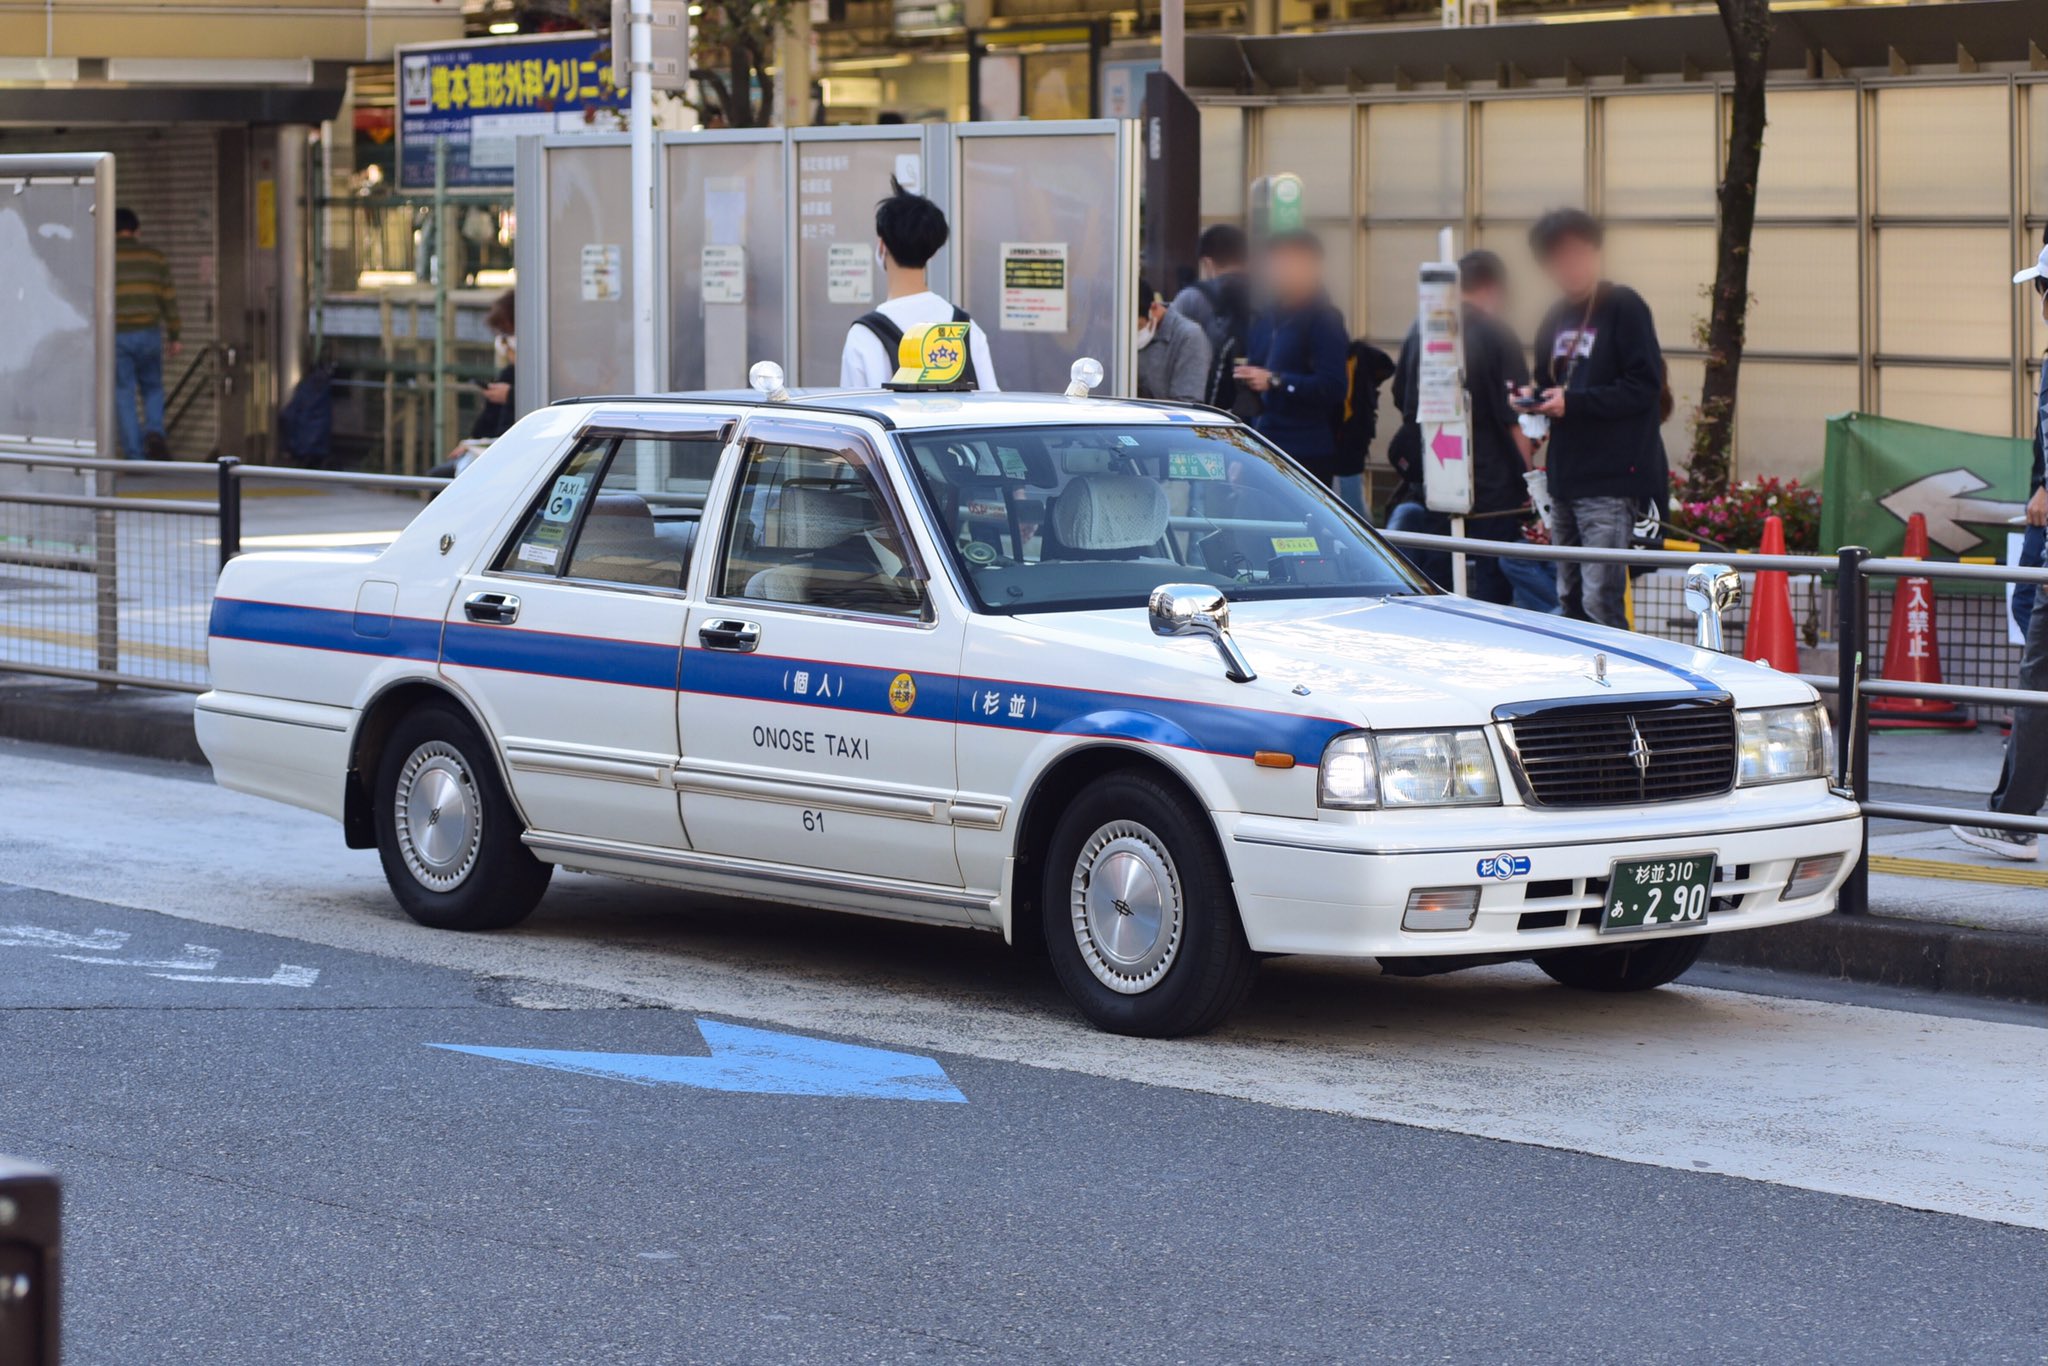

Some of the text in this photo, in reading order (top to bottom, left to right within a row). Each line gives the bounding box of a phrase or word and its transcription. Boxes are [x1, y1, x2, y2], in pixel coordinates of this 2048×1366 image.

[558, 481, 580, 496] TAXI
[550, 496, 573, 516] GO
[753, 725, 869, 760] ONOSE TAXI
[802, 809, 825, 833] 61
